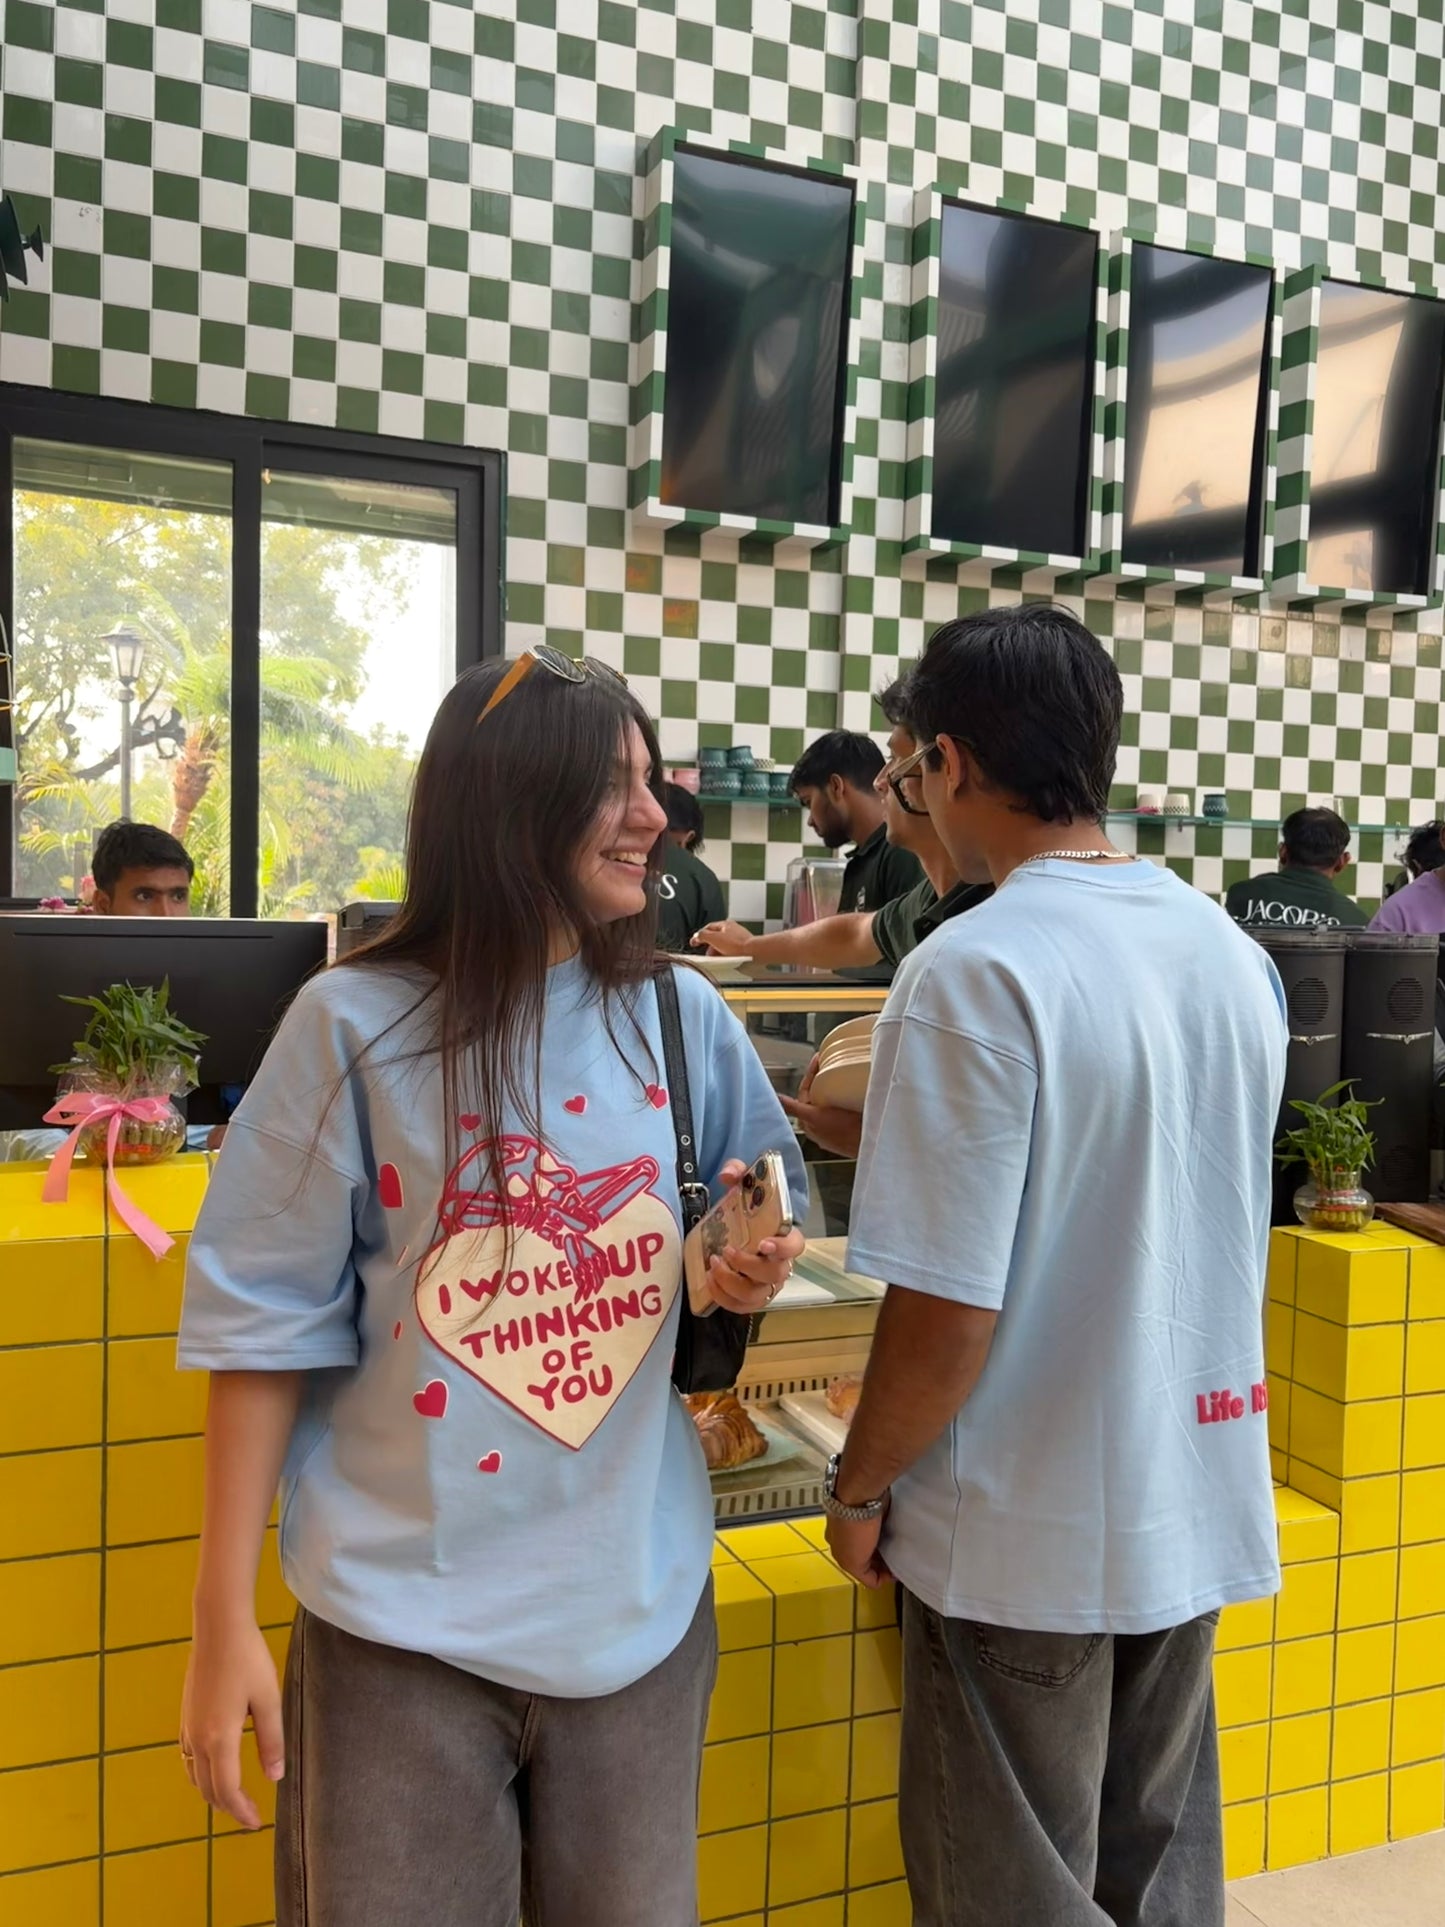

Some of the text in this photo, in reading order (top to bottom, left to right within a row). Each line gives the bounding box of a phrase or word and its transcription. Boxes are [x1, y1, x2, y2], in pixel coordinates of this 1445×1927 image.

[438, 1232, 664, 1315] I WOKE UP
[459, 1284, 662, 1359] THINKING
[542, 1340, 593, 1374] OF
[527, 1364, 613, 1411] YOU
[1196, 1389, 1245, 1424] Life
